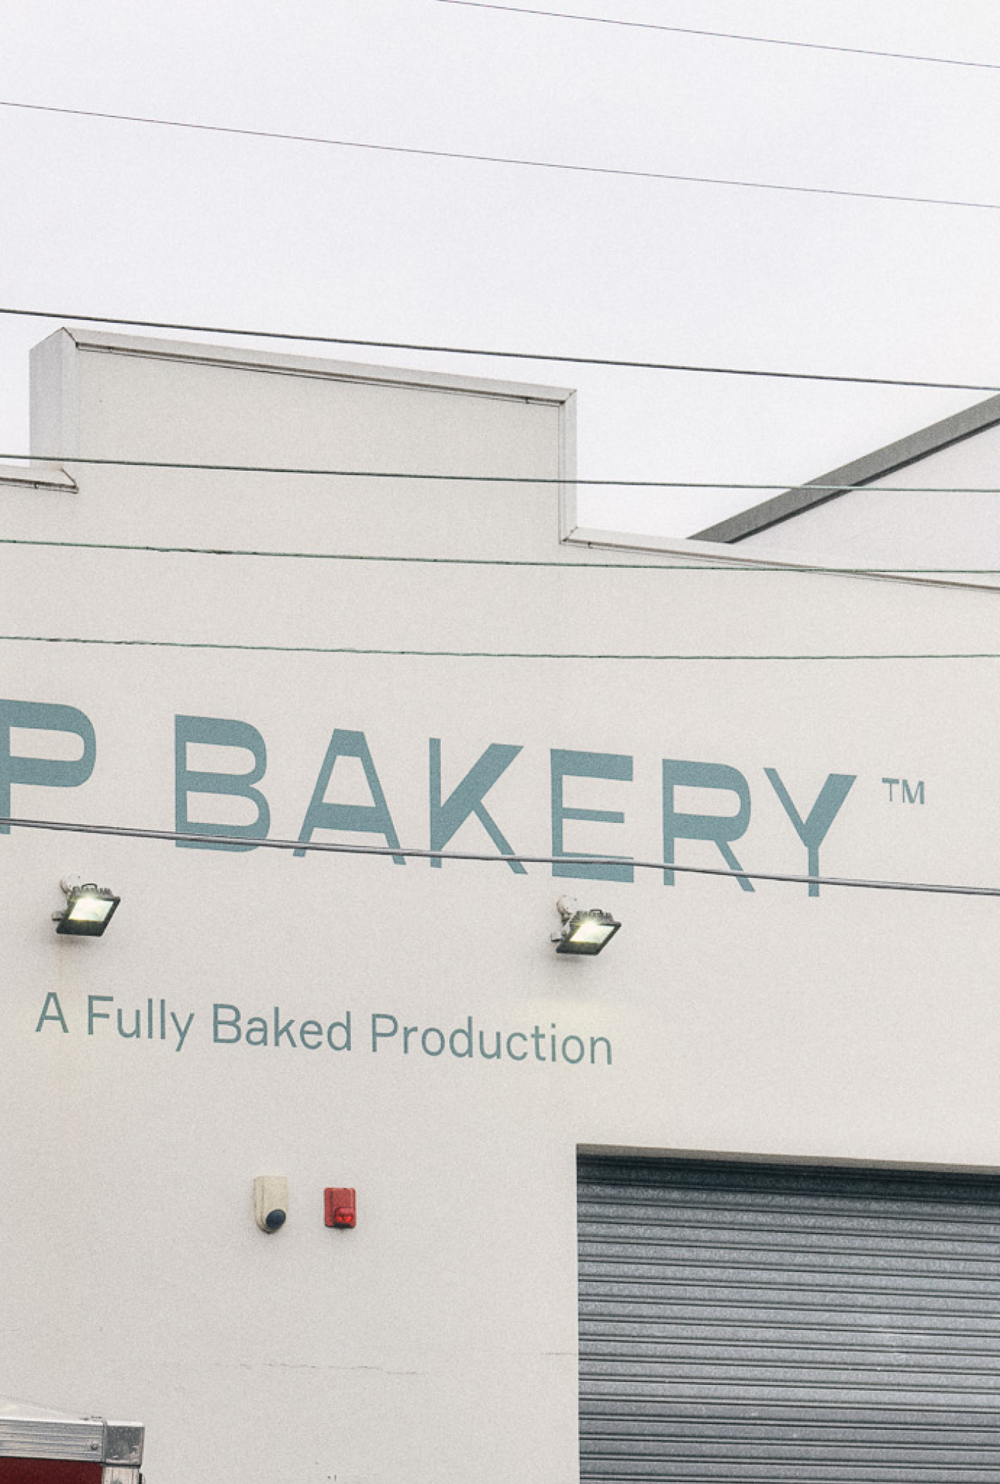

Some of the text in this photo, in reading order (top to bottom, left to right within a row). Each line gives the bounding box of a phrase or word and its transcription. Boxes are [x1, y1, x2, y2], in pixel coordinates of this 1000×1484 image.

[174, 715, 856, 897] BAKERY
[35, 992, 613, 1065] A Fully Baked Production
